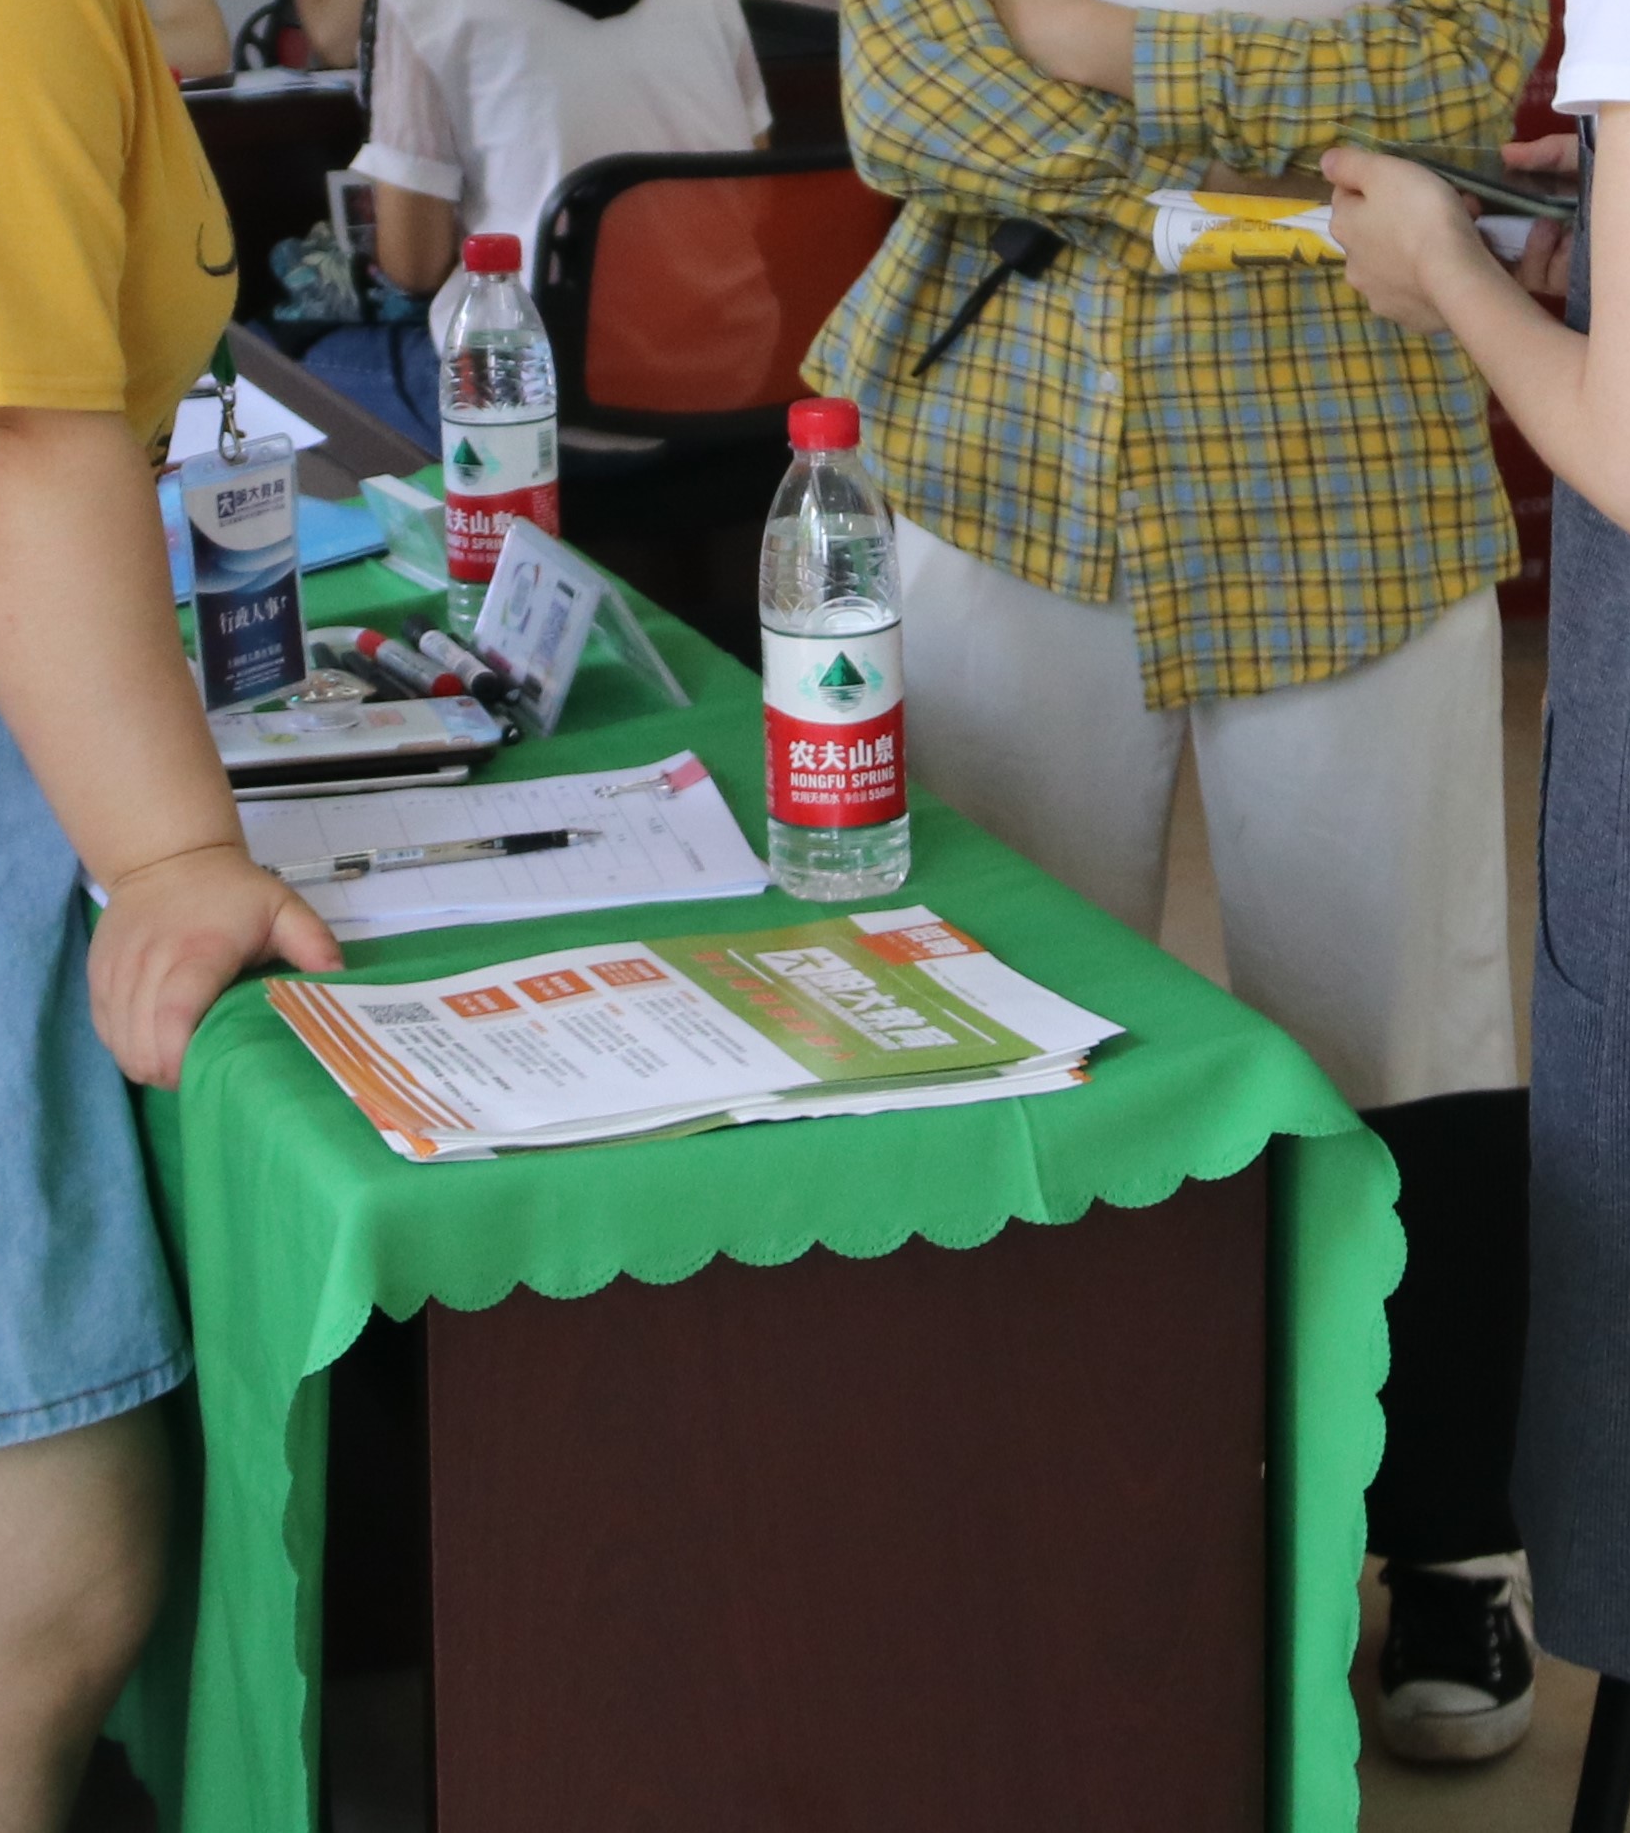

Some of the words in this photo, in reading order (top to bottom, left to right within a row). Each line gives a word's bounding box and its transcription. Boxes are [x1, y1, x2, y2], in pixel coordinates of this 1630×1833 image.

[789, 733, 895, 771] 农夫山泉
[790, 772, 846, 789] NONGFU
[852, 766, 896, 788] SPRING
